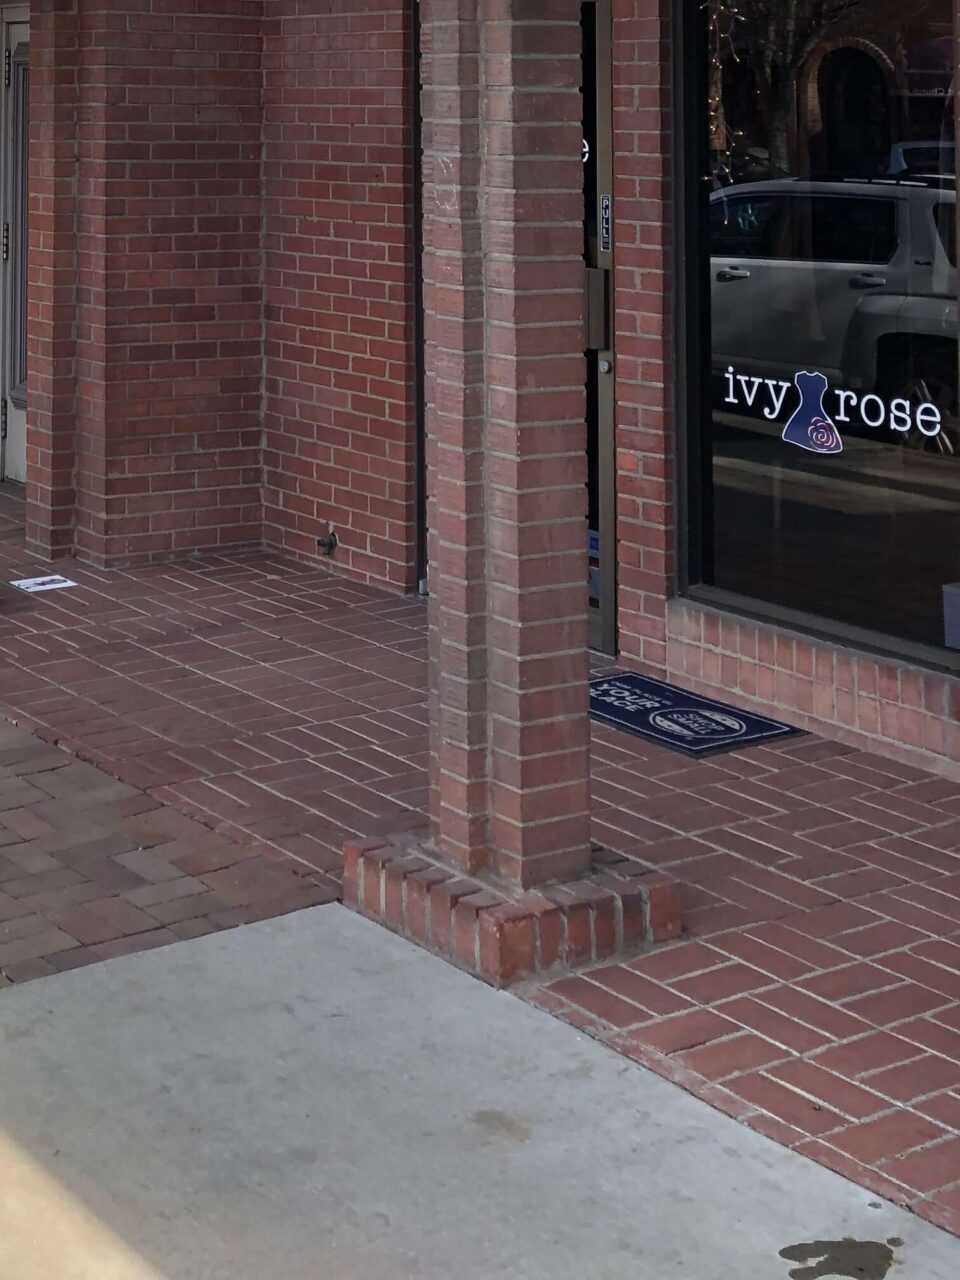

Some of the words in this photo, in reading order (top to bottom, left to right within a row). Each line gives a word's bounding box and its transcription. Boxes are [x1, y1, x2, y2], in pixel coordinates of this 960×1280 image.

[602, 199, 610, 238] PULL
[724, 366, 791, 419] ivy
[835, 388, 941, 437] rose
[598, 683, 661, 709] YOUR
